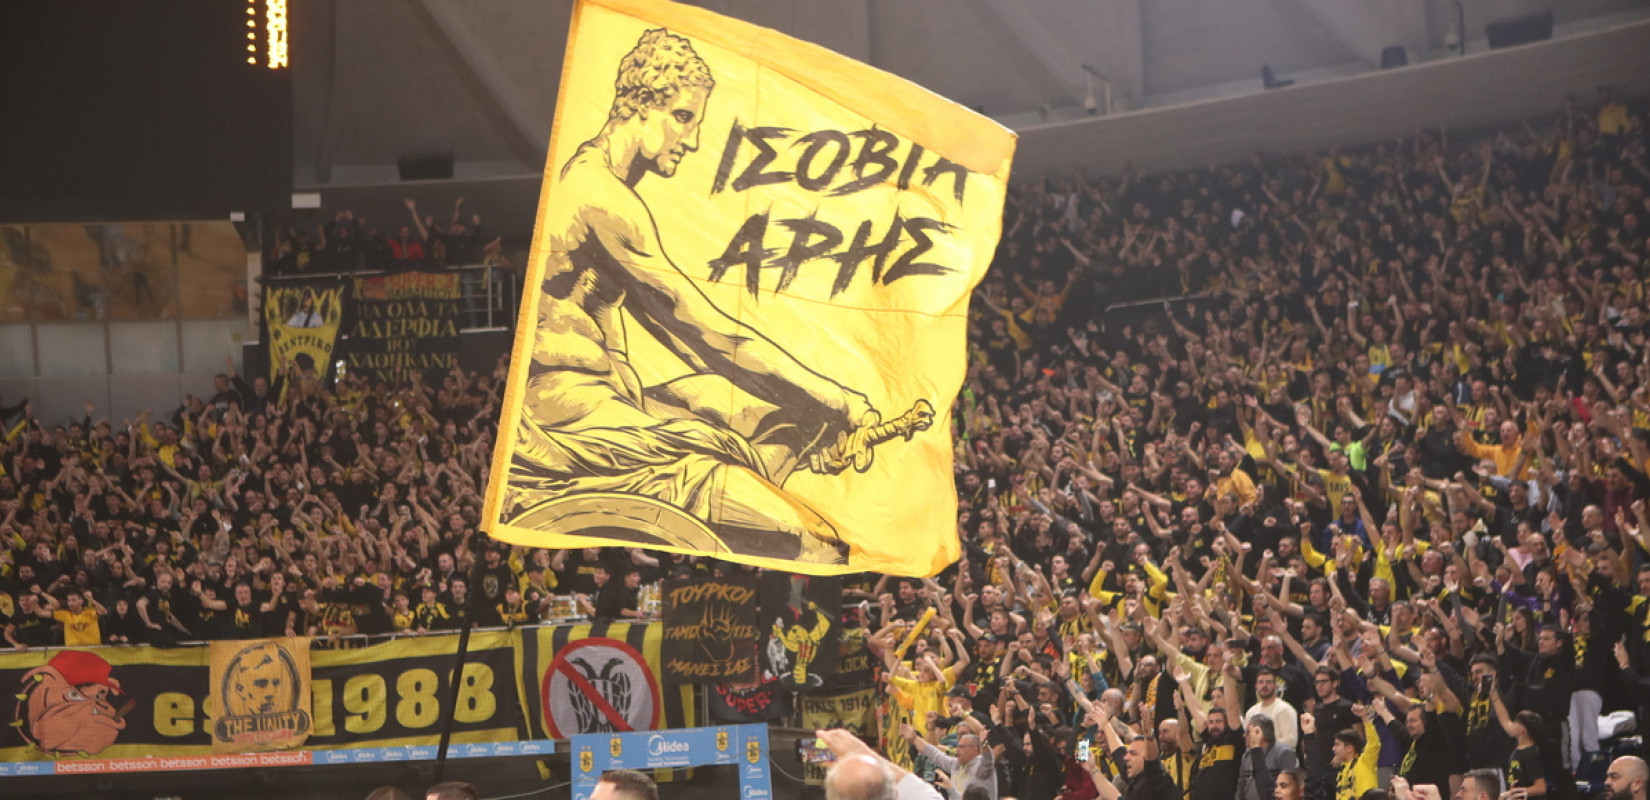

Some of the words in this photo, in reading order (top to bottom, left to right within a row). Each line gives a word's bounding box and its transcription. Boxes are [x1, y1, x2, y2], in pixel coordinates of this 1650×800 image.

[706, 200, 962, 304] ΑΡΗΣ
[224, 717, 253, 738] THE
[57, 762, 105, 773] betsson
[110, 759, 157, 771] betsson
[161, 757, 208, 769] betsson
[211, 755, 258, 767] betsson
